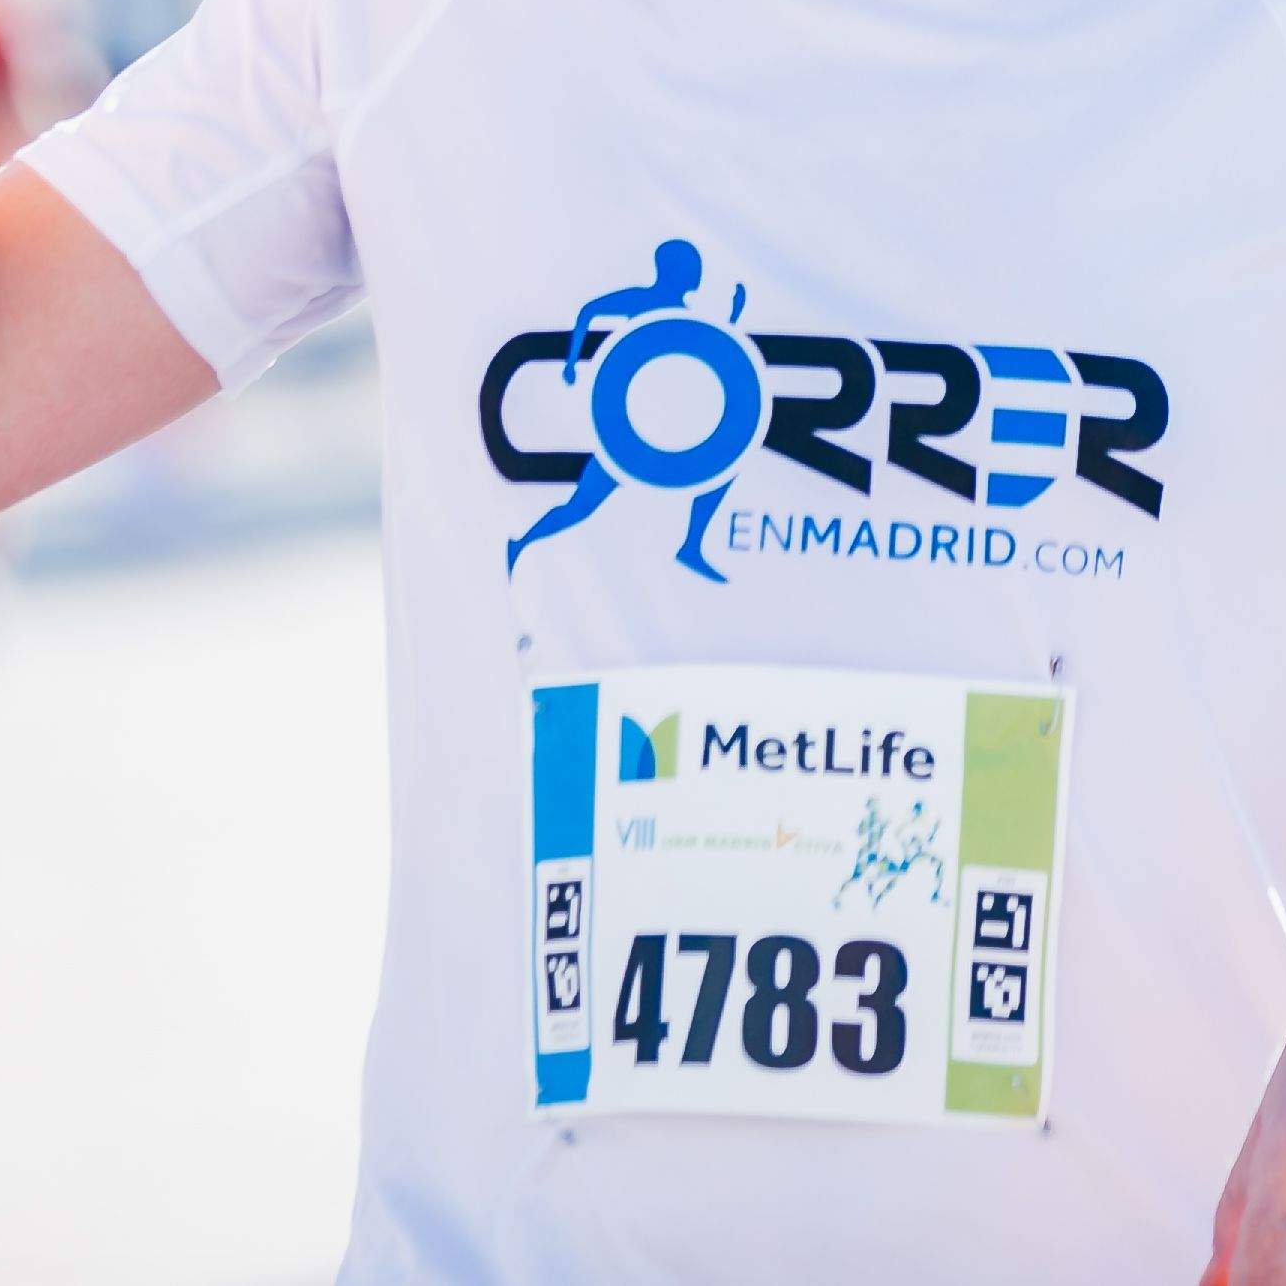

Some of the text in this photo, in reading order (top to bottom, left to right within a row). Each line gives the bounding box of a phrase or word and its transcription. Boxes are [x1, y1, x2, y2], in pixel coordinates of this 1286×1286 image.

[479, 317, 1170, 522] CORRER
[727, 511, 1126, 580] ENMADRID.COM
[700, 722, 936, 781] MetLife
[613, 932, 909, 1075] 4783
